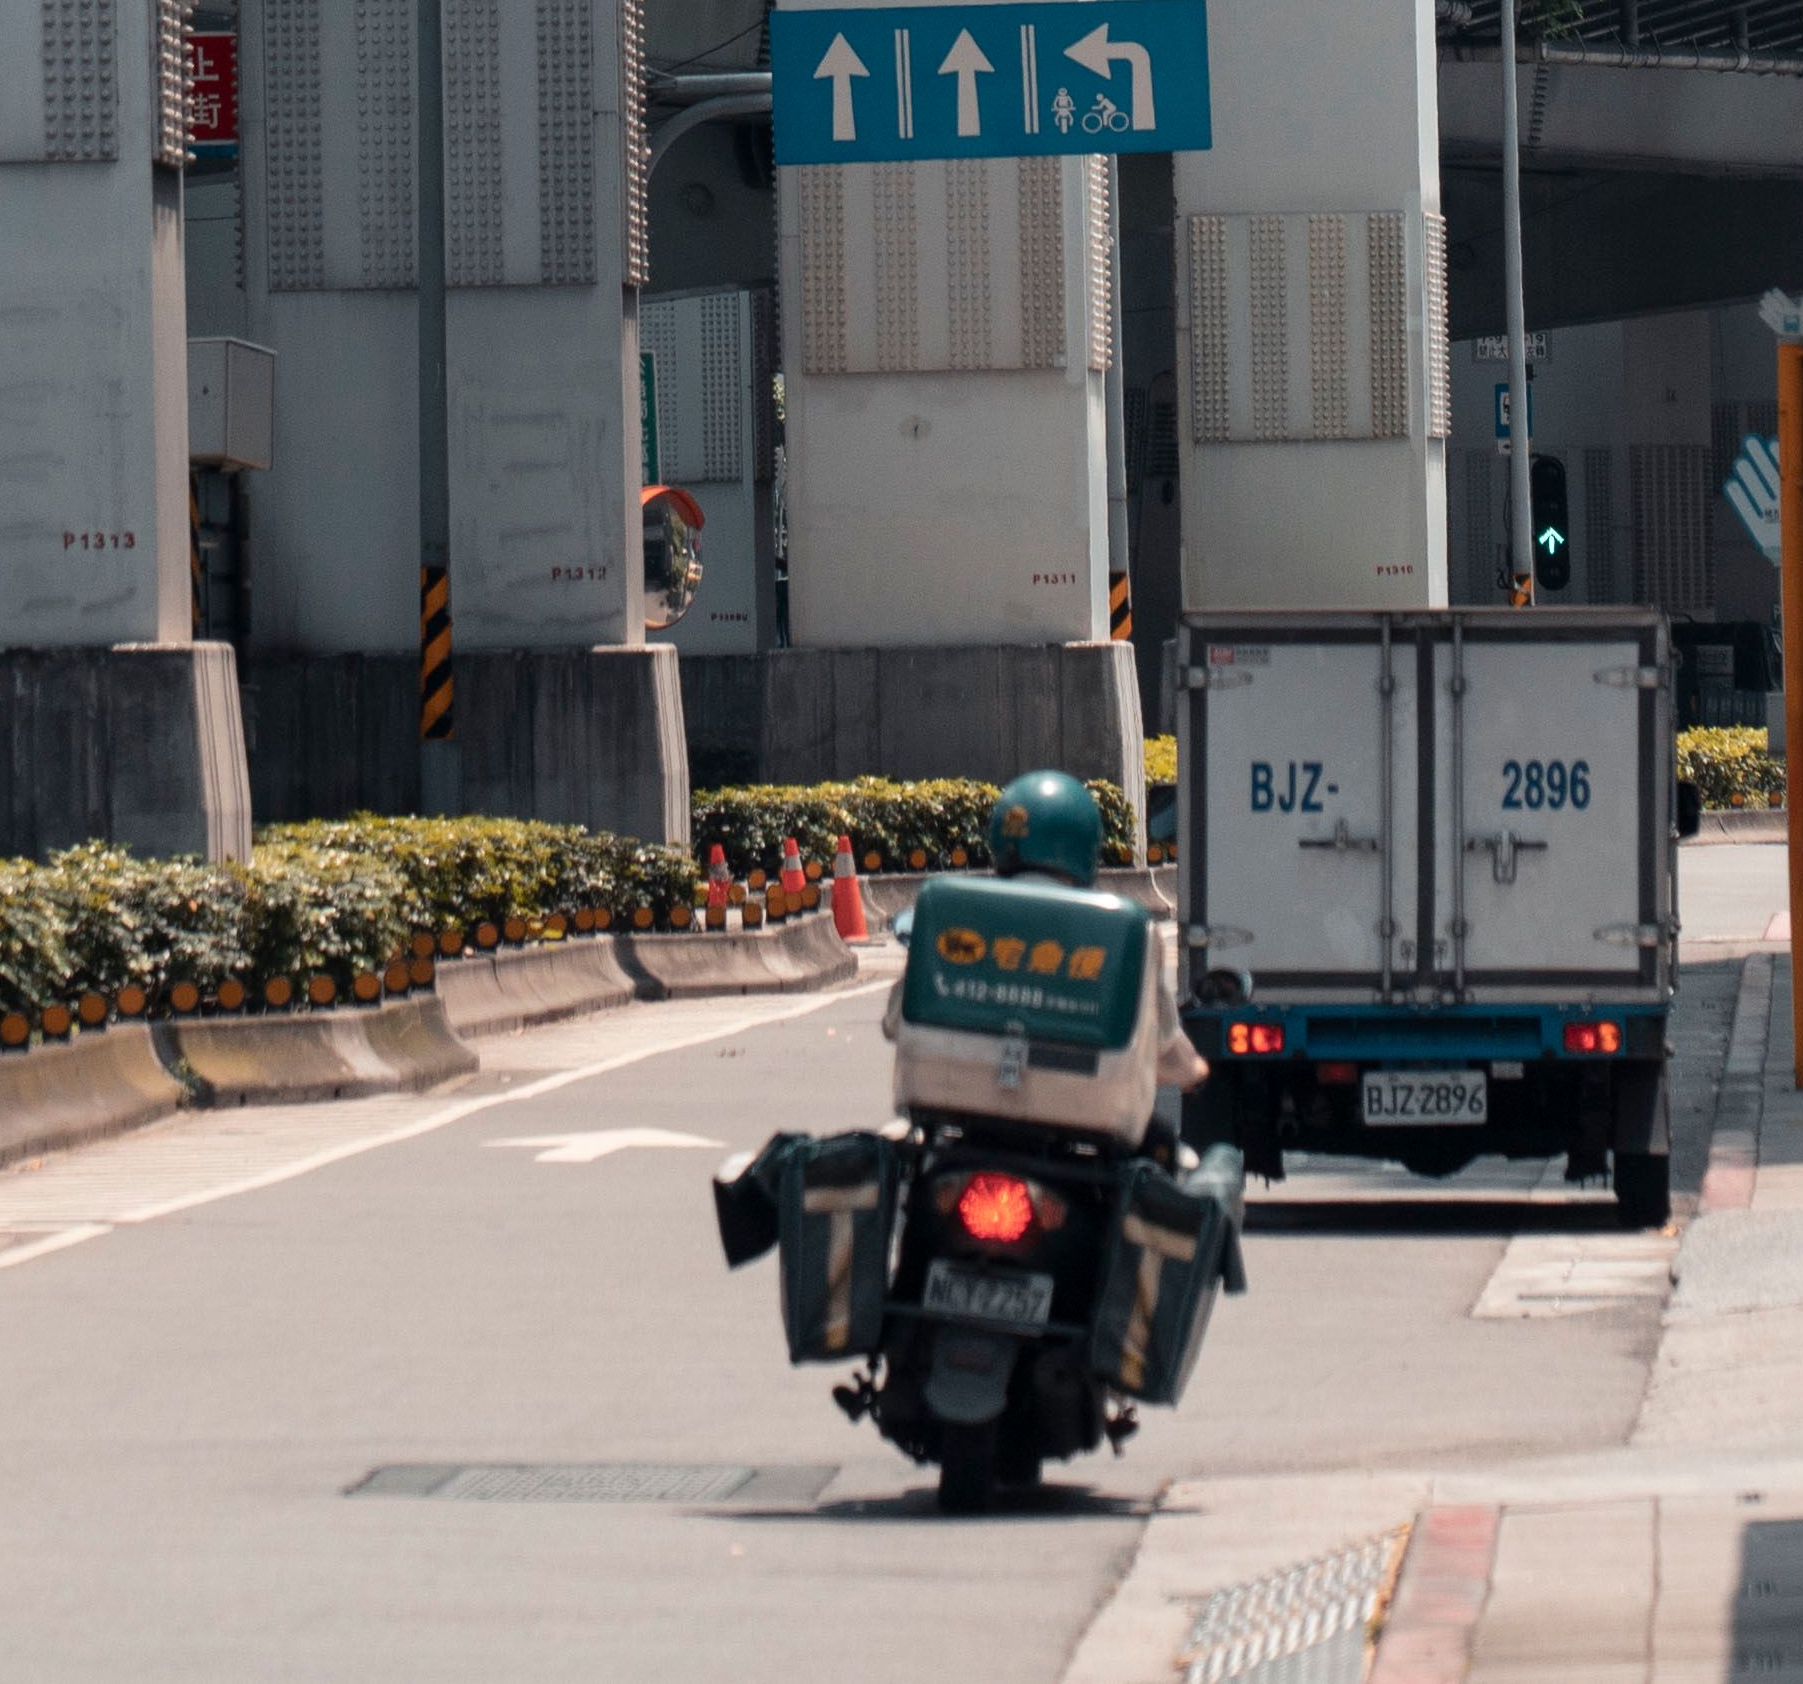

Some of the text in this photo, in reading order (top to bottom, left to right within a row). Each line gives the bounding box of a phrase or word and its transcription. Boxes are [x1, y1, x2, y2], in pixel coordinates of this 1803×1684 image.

[64, 531, 135, 550] P1313
[1251, 760, 1591, 812] BJZ- 2896
